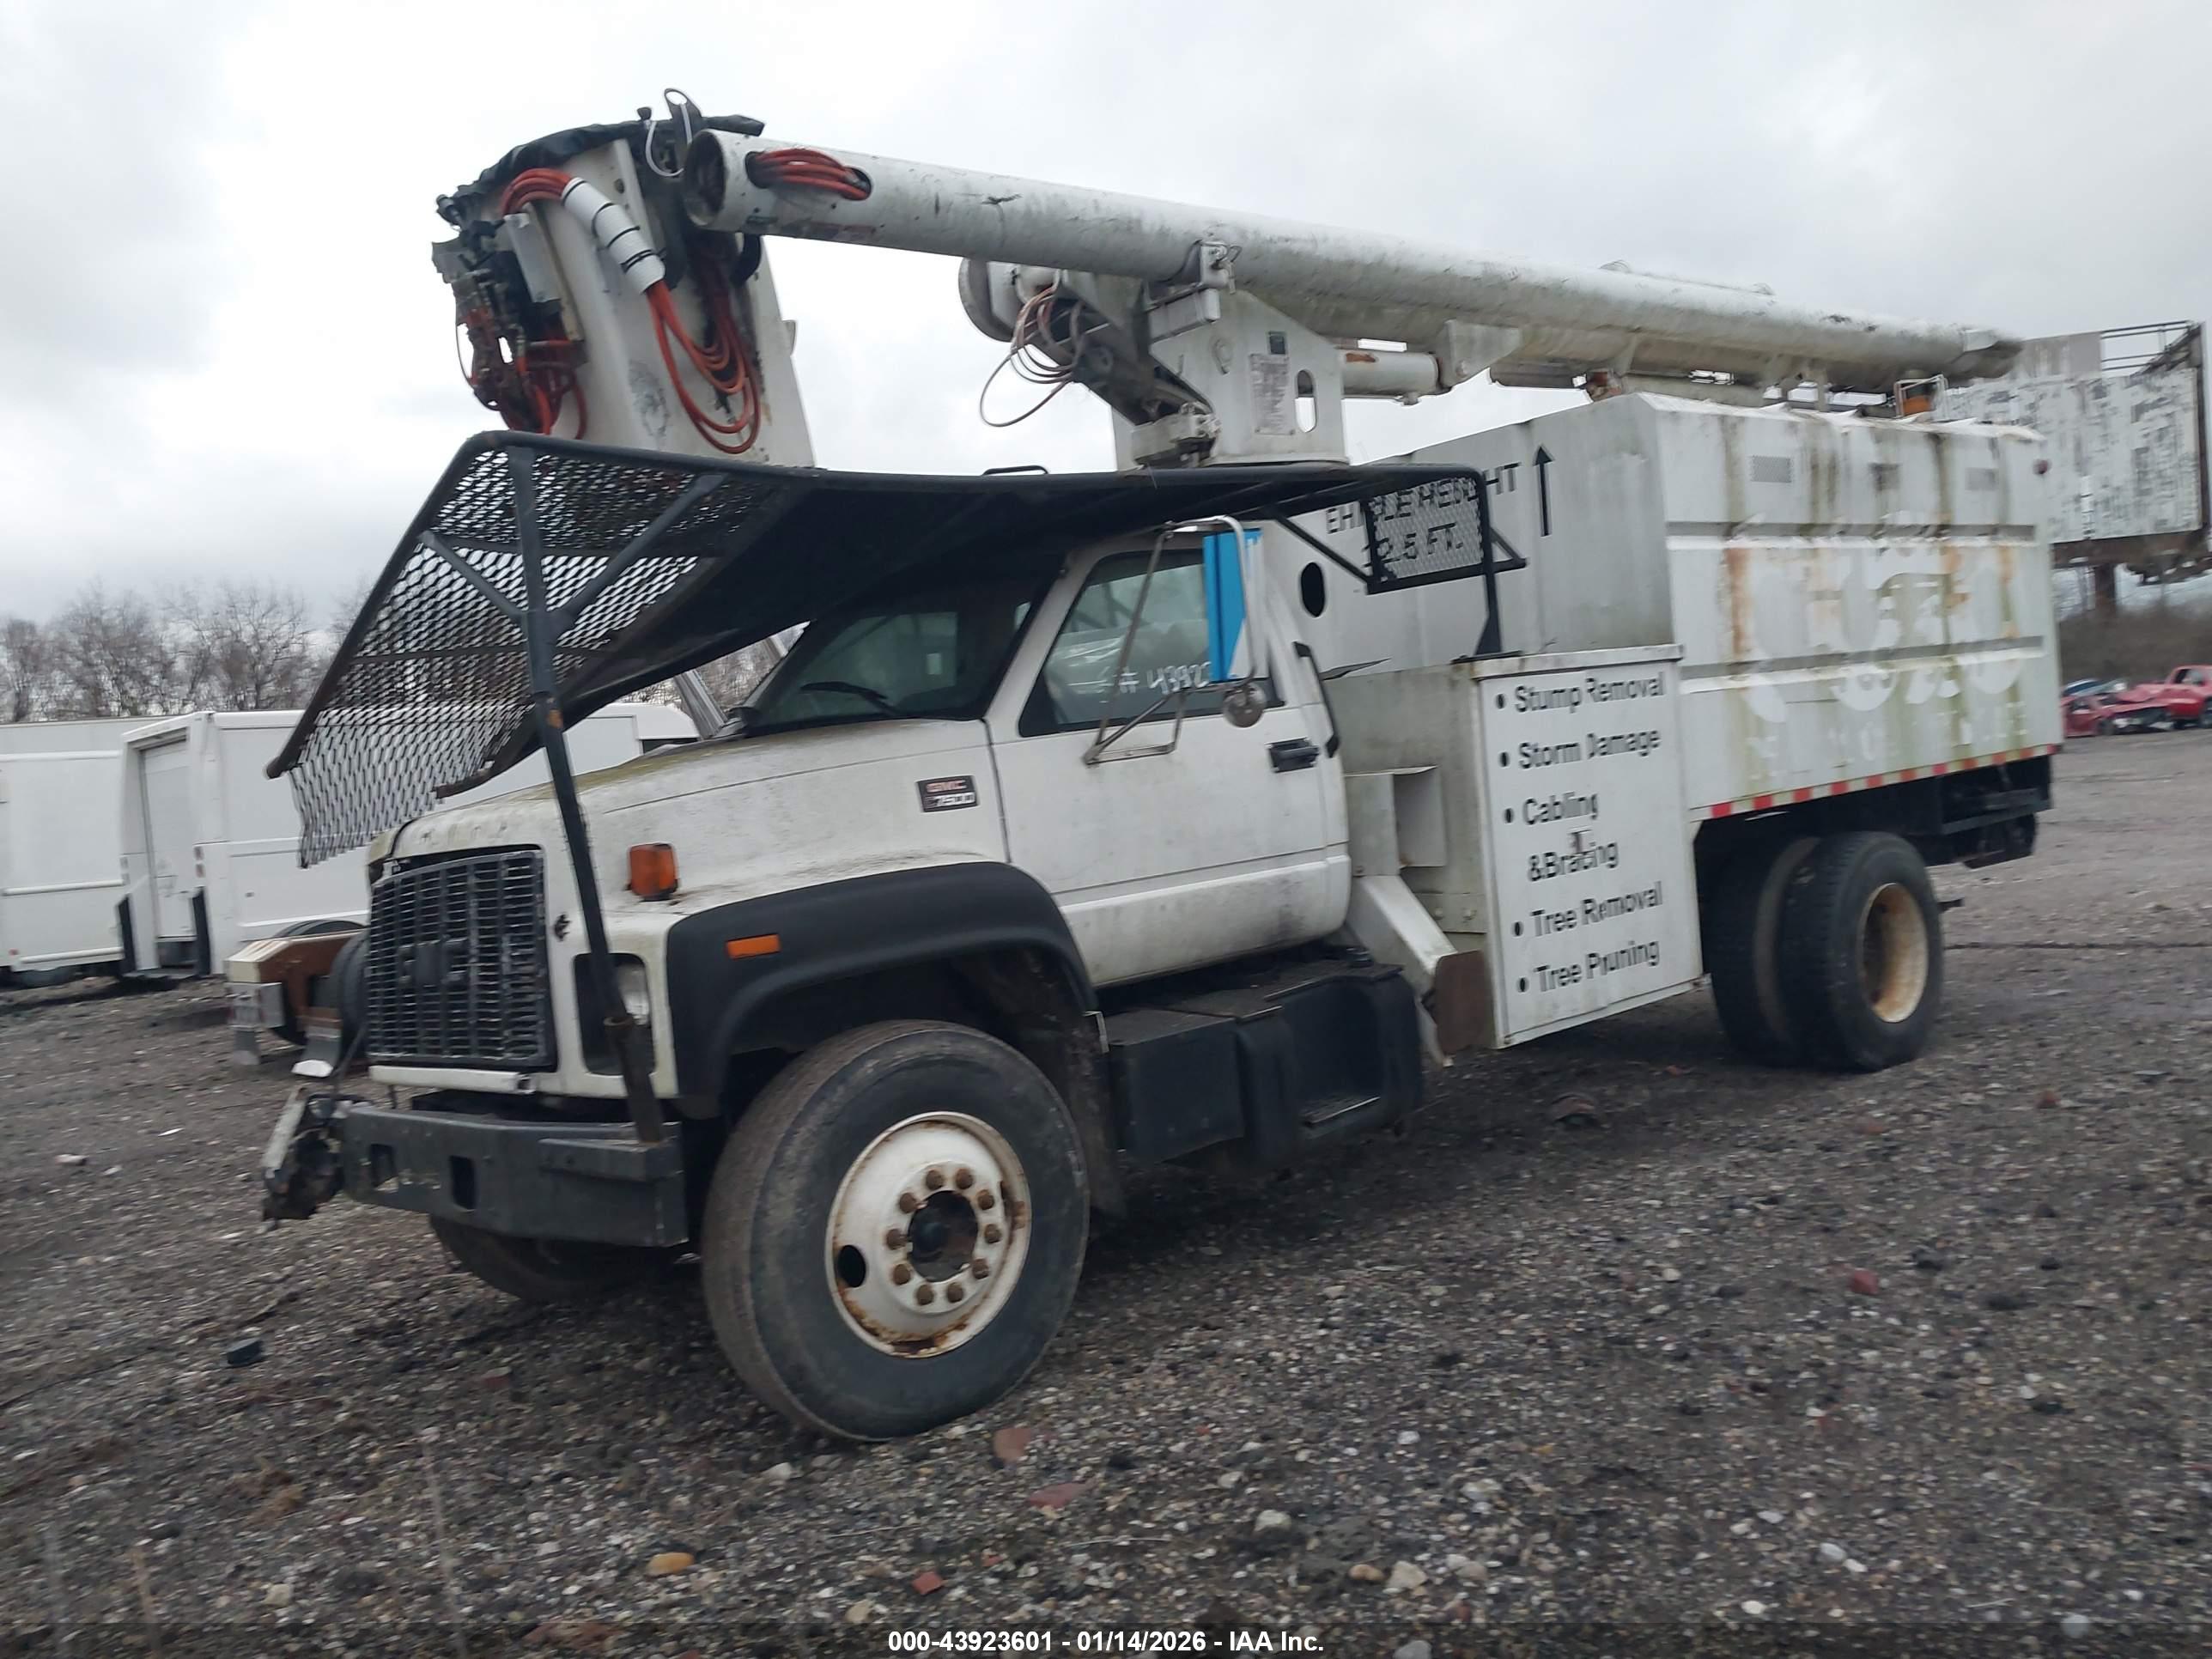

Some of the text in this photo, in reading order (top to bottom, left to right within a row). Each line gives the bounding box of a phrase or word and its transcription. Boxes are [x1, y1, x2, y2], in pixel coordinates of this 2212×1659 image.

[1515, 671, 1666, 714] Stump Removal
[1518, 729, 1662, 769] Storm Damage
[1522, 791, 1599, 825] Cabling
[1528, 880, 1663, 937] Tree Removal
[1533, 939, 1661, 993] Tree Pruning
